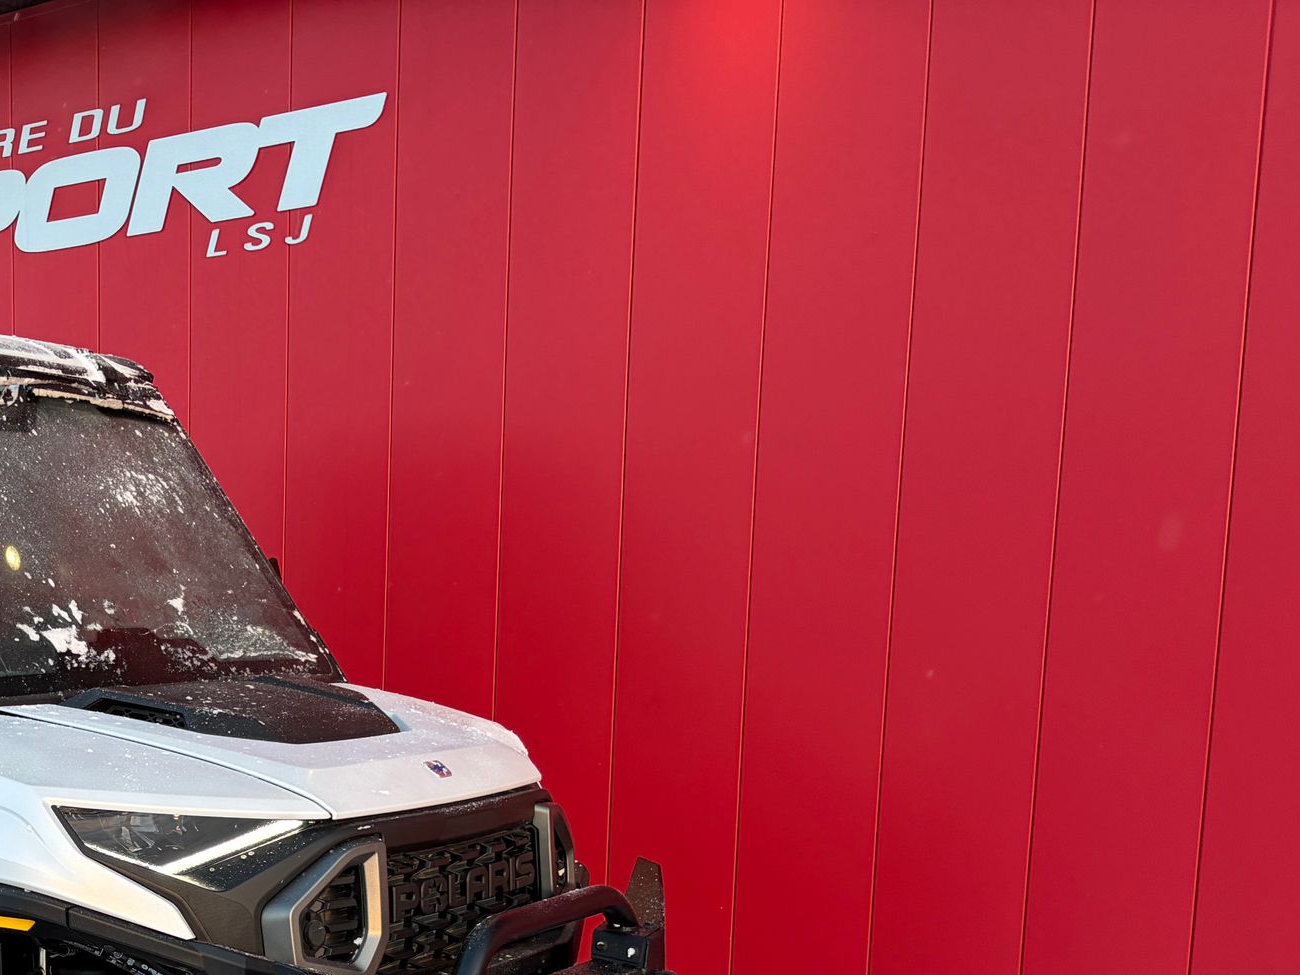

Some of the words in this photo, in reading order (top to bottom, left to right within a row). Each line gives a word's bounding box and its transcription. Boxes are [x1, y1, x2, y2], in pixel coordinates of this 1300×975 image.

[69, 98, 147, 143] DU
[206, 214, 312, 258] LSJ
[392, 850, 536, 923] POLARIS
